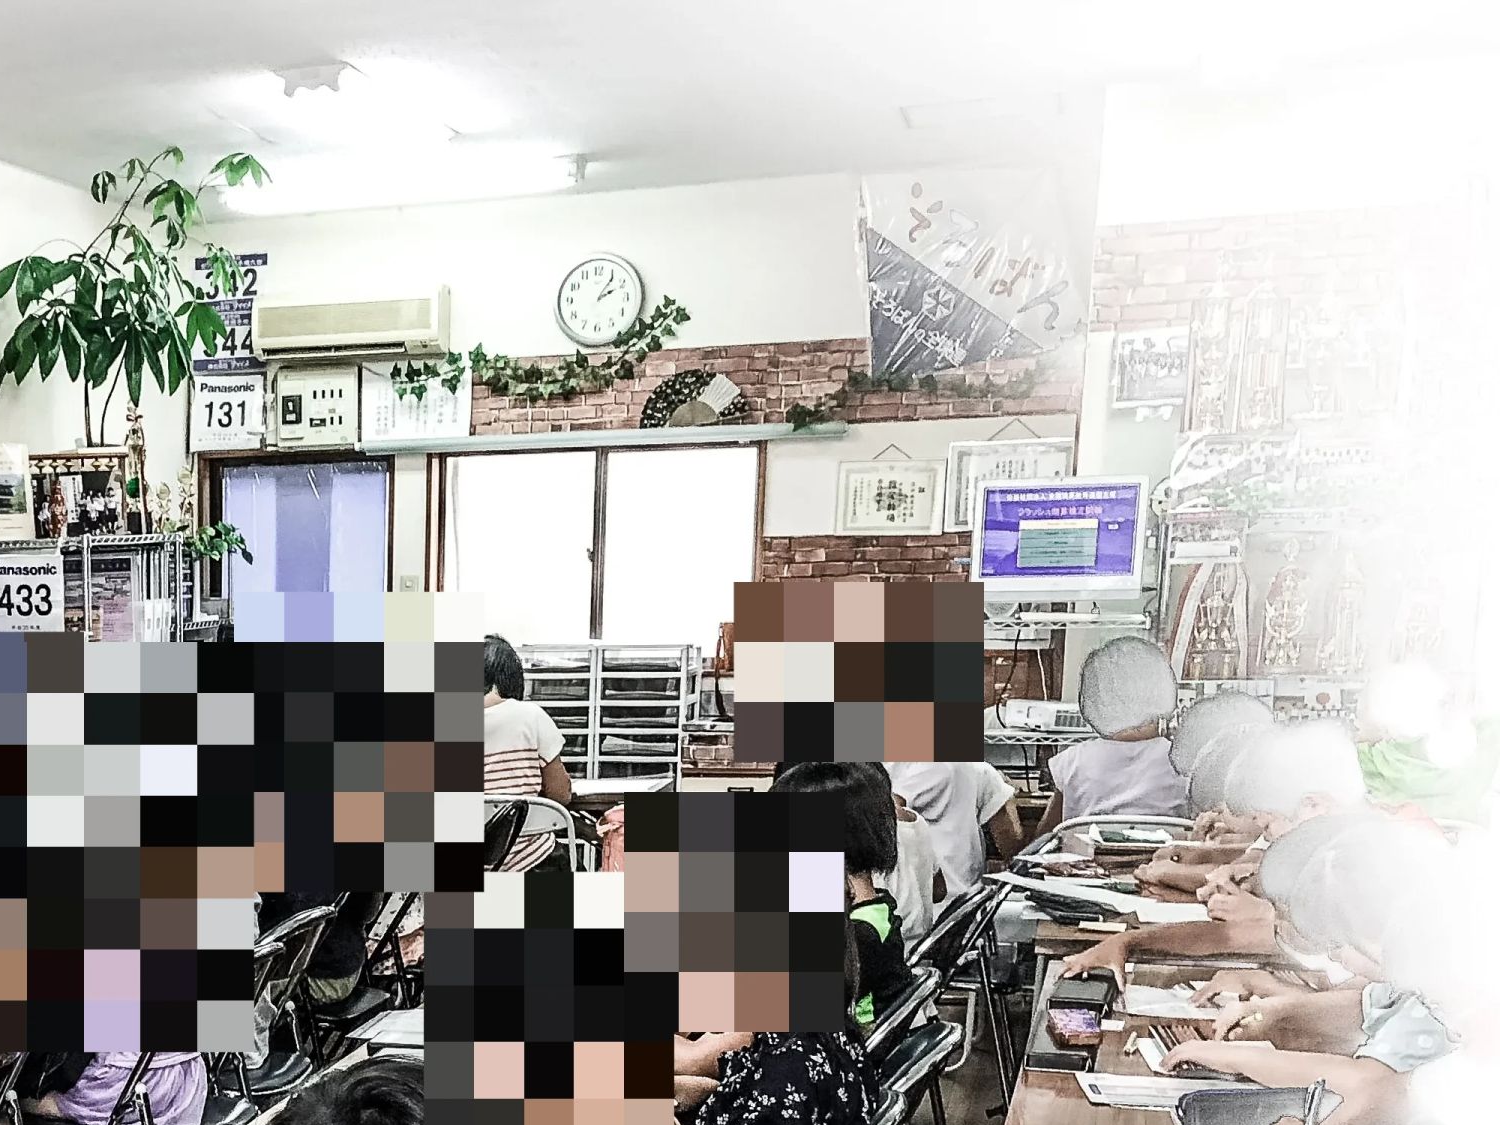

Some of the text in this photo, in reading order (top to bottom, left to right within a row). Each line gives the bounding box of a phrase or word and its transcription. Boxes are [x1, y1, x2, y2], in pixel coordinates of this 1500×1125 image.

[581, 270, 589, 280] 11
[594, 266, 604, 276] 12
[570, 281, 580, 292] 10
[200, 381, 255, 393] Panasonic
[204, 400, 246, 428] 131
